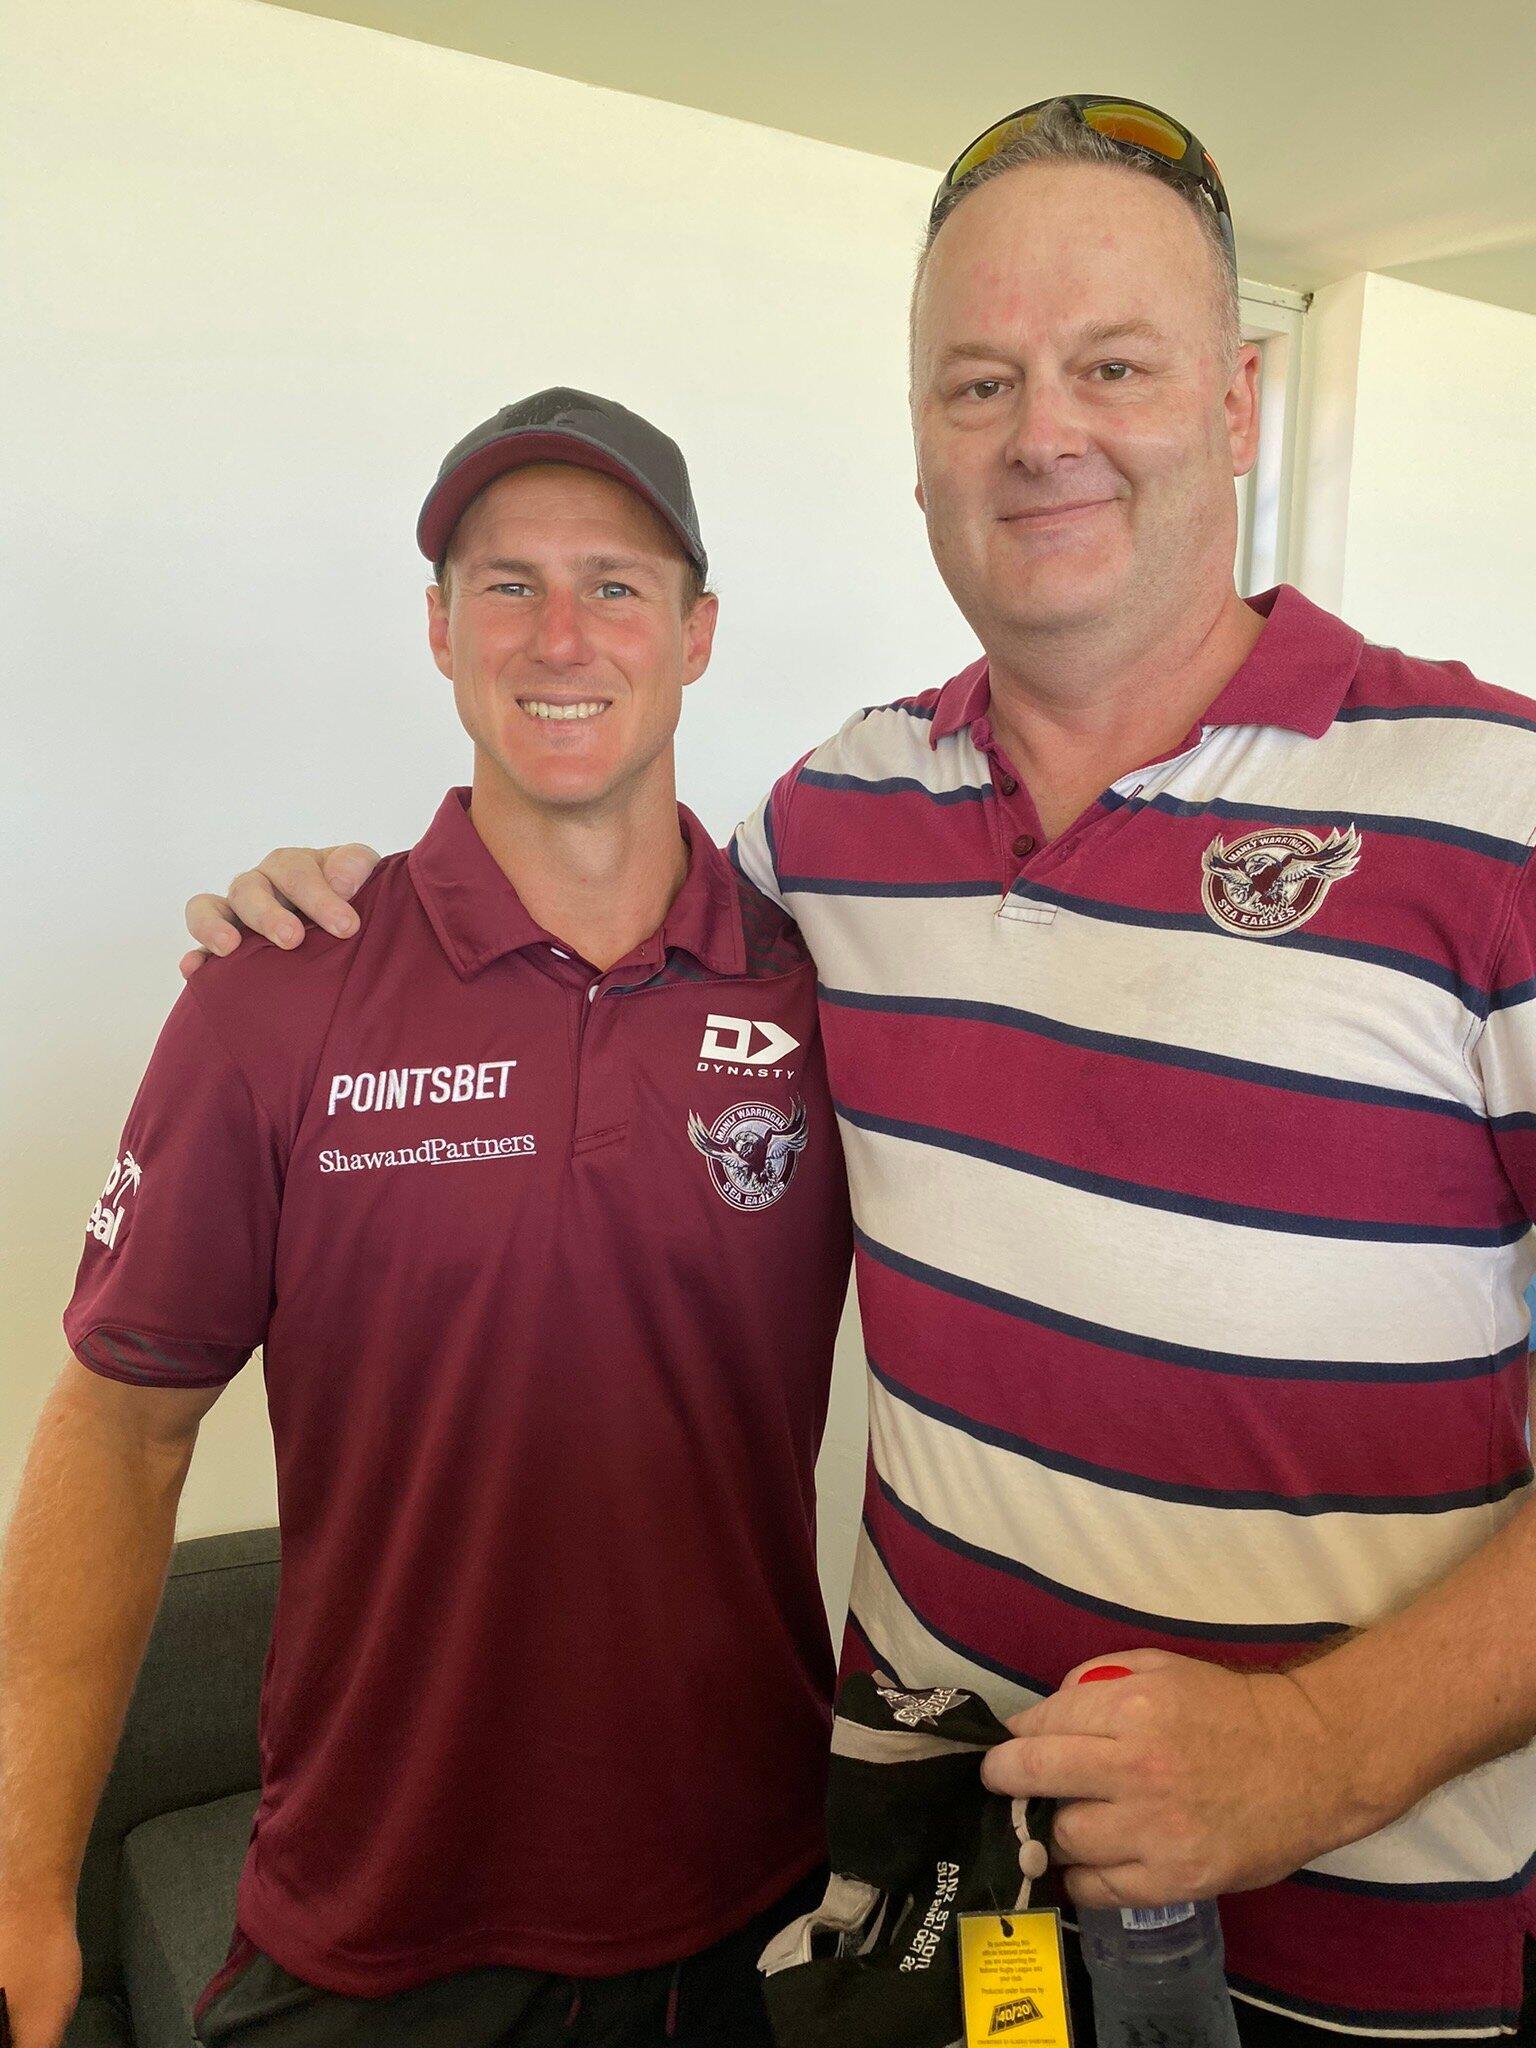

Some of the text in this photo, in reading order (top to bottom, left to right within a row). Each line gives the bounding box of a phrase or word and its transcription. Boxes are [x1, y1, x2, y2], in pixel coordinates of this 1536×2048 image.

[1228, 836, 1312, 862] MANLY WARRINGAH
[1218, 898, 1297, 926] SEA EAGLES
[696, 1062, 795, 1080] DYNASTY
[327, 1060, 517, 1116] POINTSBET
[715, 1107, 787, 1141] MANLY WARRINGAH
[318, 1134, 537, 1173] ShawandPartners
[723, 1181, 786, 1205] SEA EAGLES
[936, 1861, 948, 1896] SUN
[942, 1862, 960, 1903] ANZ
[923, 1898, 942, 1927] 2ND
[909, 1928, 929, 1954] OCT
[997, 2003, 1031, 2023] 40/20
